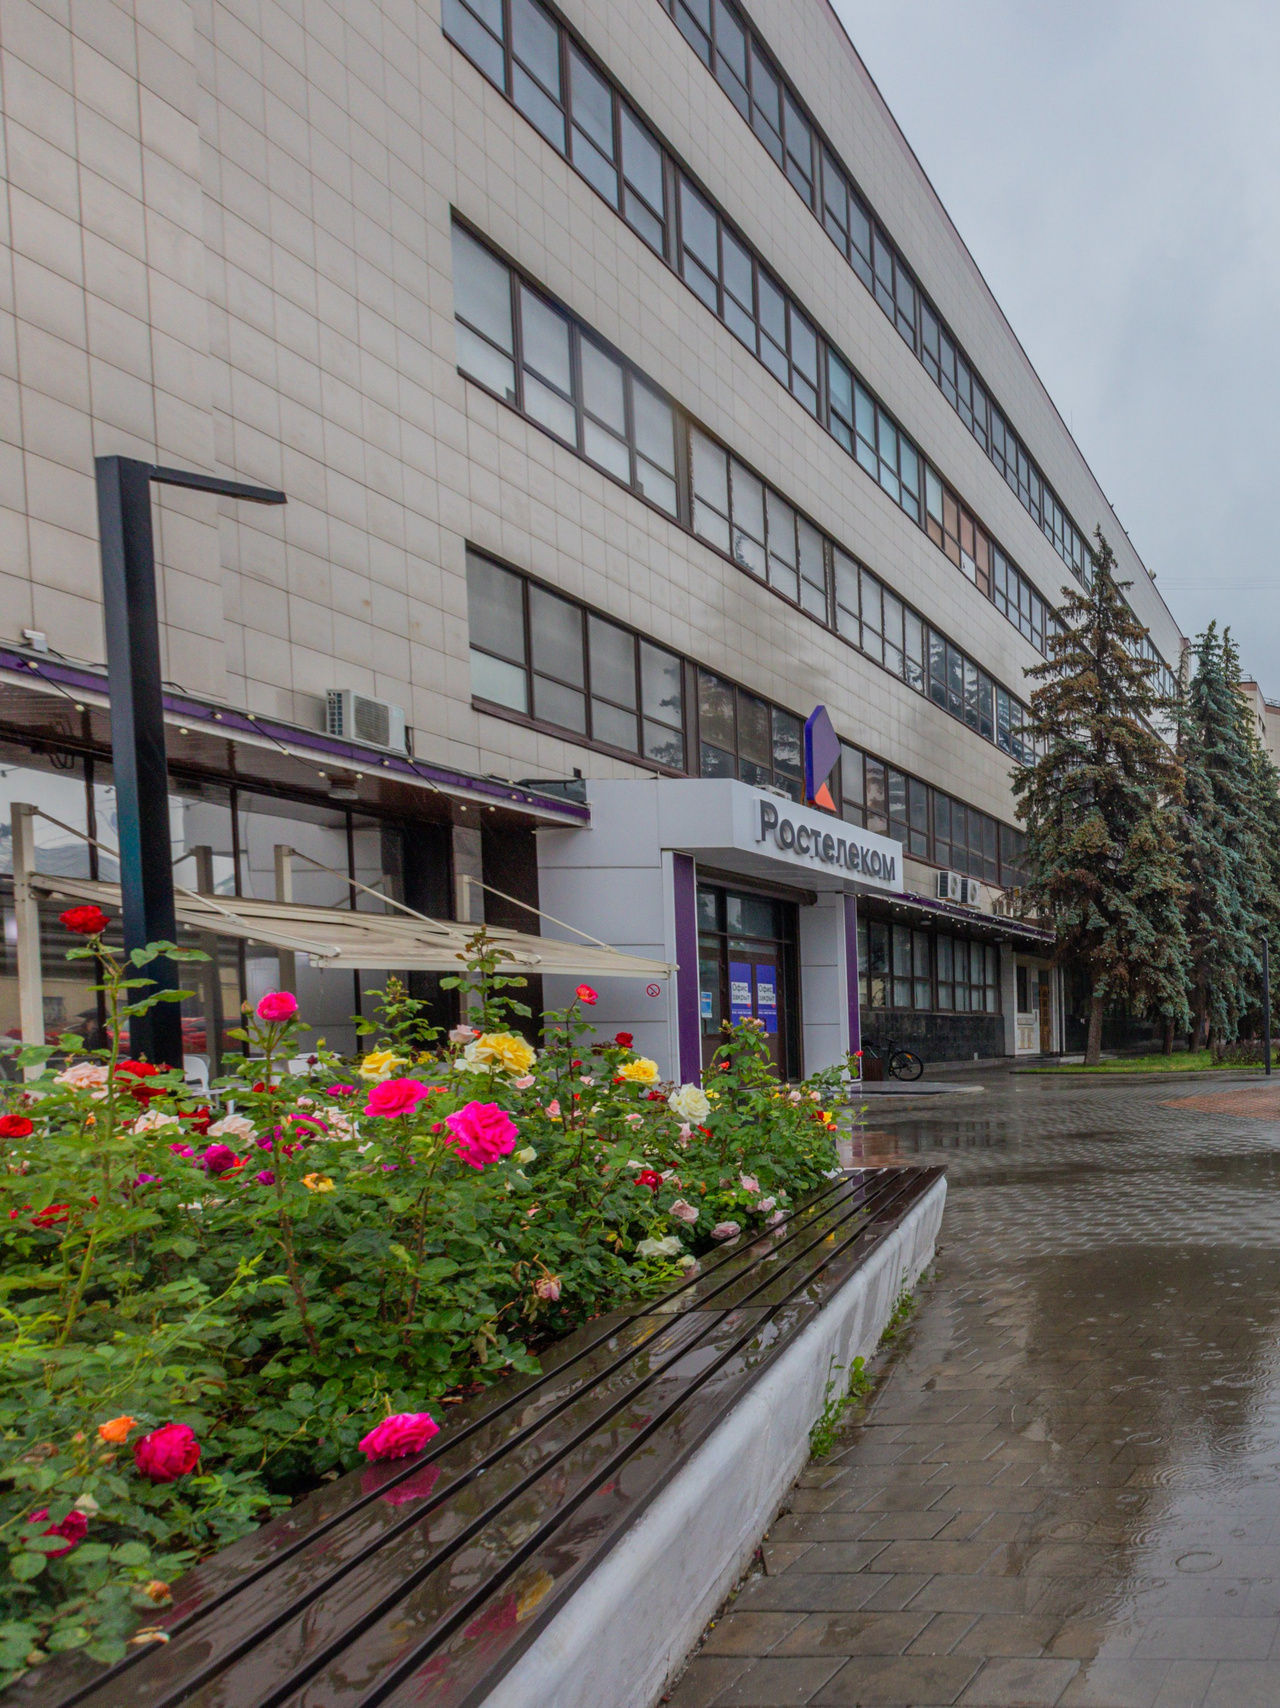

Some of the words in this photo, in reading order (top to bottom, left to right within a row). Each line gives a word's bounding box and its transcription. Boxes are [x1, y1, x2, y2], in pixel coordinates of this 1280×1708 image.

[757, 798, 896, 881] Ростелеком
[732, 983, 748, 992] Офис
[759, 984, 772, 993] Офис
[732, 994, 750, 1002] закрыт
